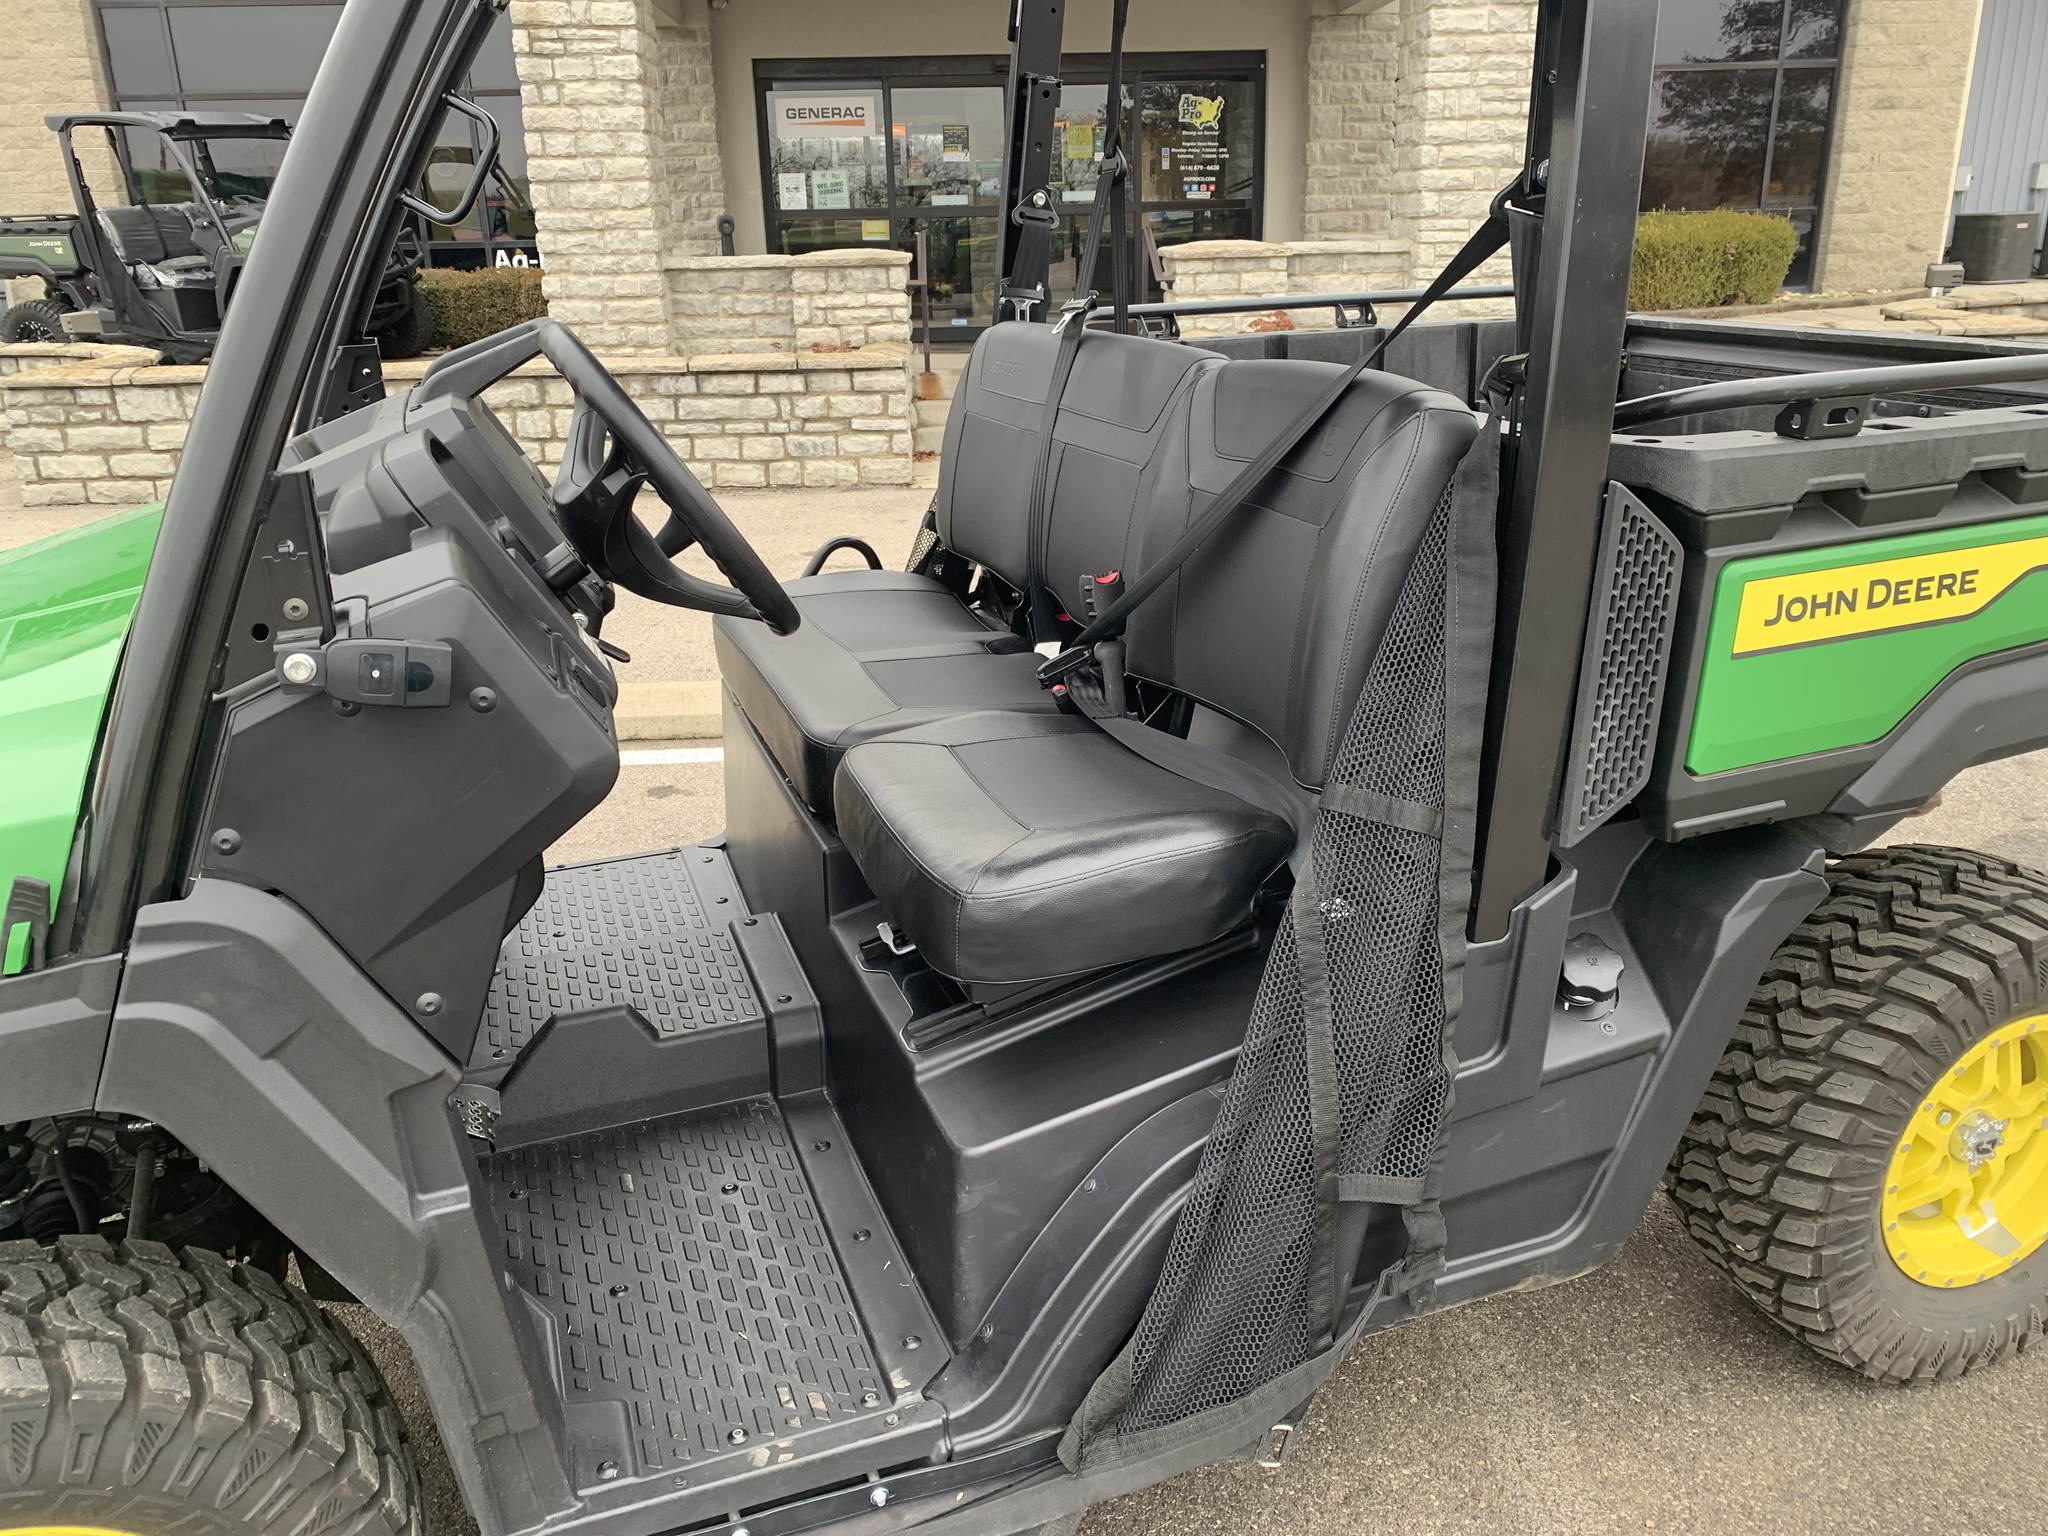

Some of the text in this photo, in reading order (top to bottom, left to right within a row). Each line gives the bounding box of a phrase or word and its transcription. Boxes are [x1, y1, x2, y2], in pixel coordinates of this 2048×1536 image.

[1182, 97, 1202, 109] Ag-
[786, 107, 865, 119] GENERAC
[1181, 109, 1202, 119] Pro
[818, 188, 844, 196] HIRING
[1764, 569, 1979, 627] JOHN DEERE
